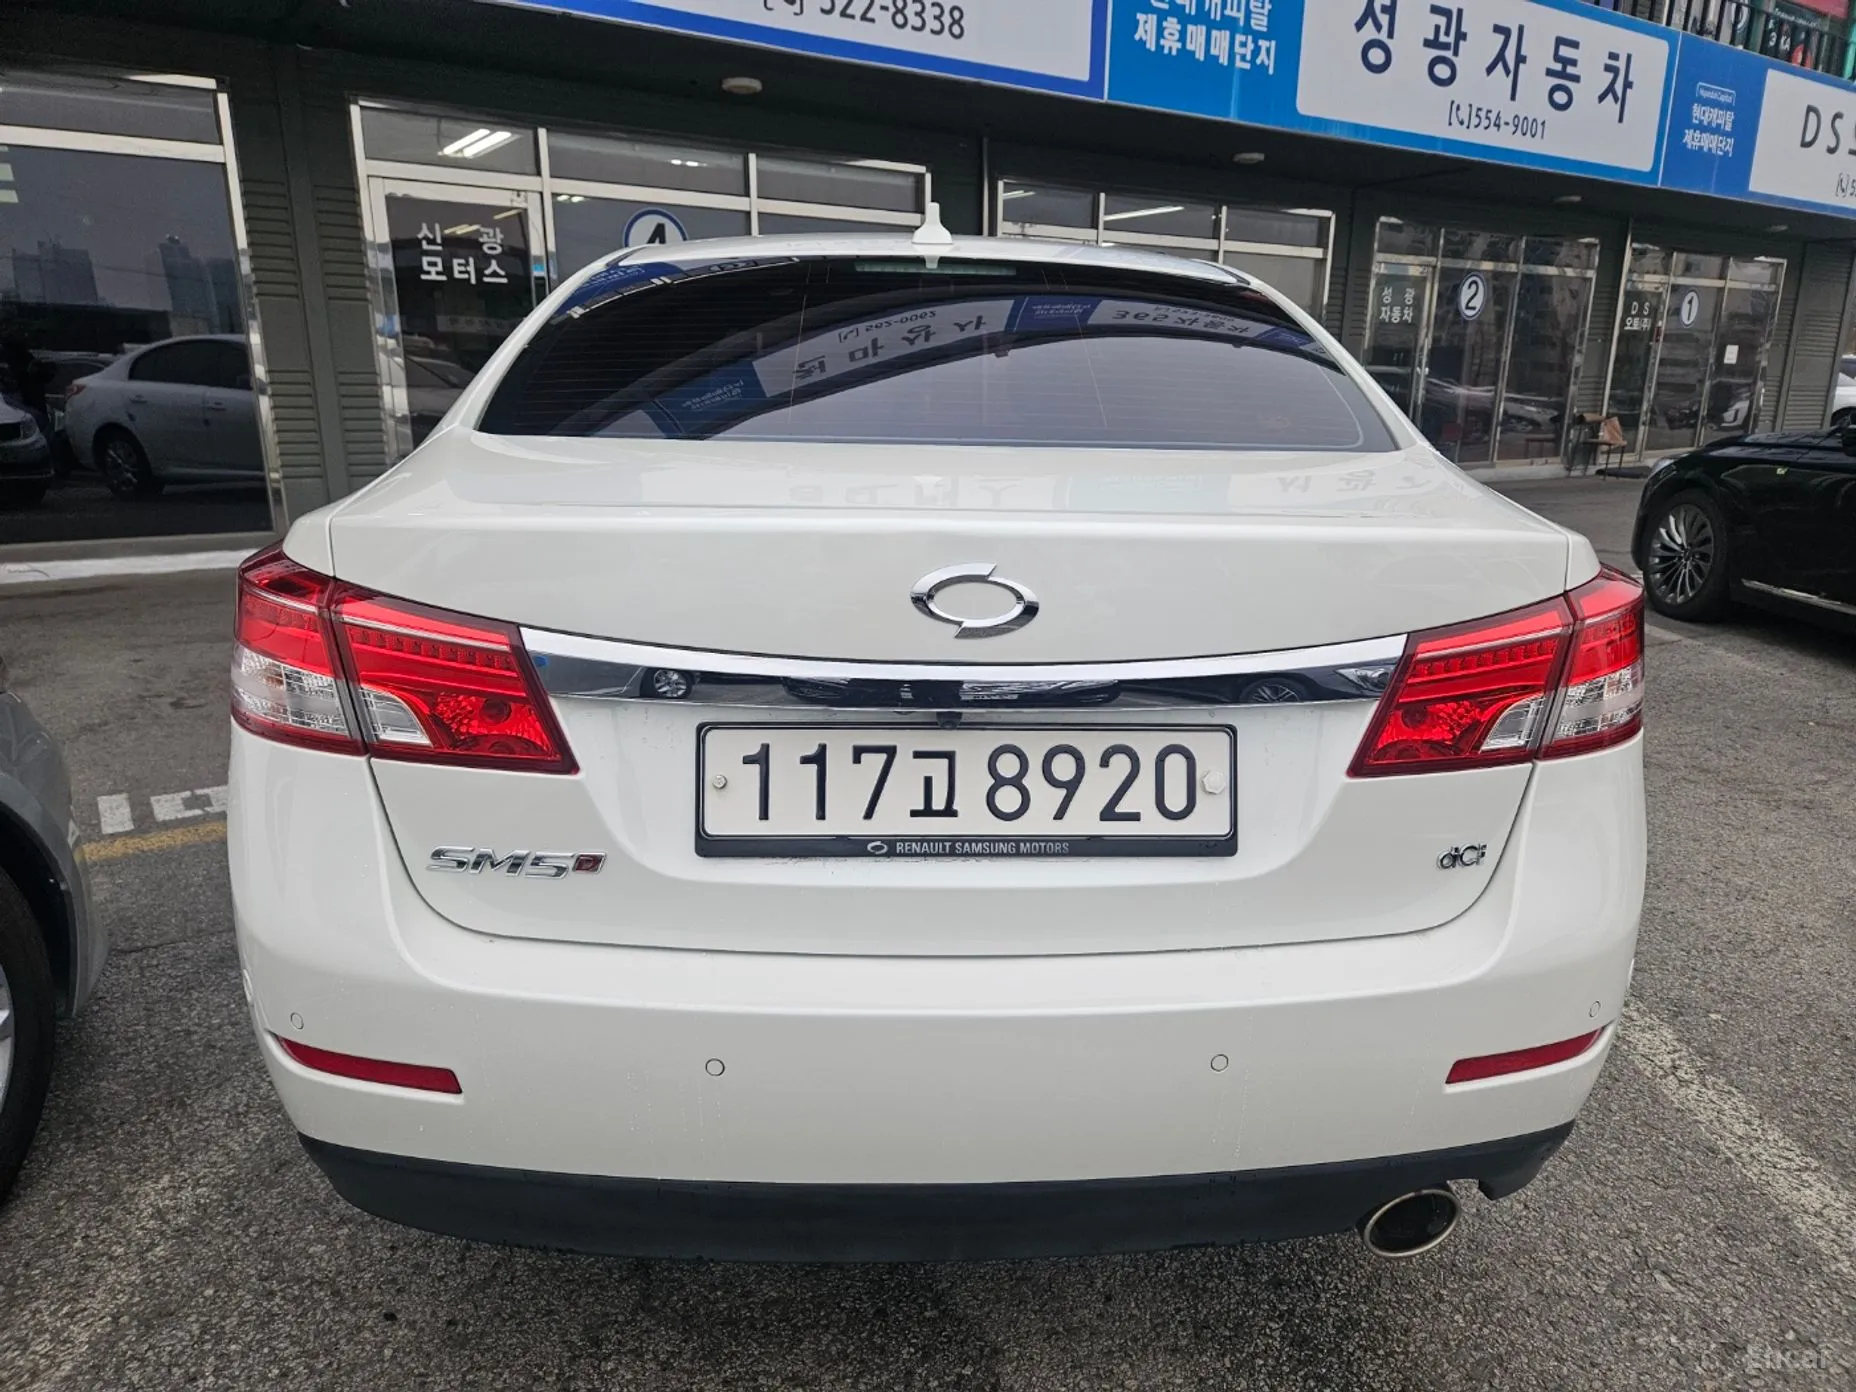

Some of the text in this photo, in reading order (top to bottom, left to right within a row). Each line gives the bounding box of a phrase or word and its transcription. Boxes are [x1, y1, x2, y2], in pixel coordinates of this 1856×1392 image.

[1134, 12, 1276, 75] 제휴매매단지
[420, 256, 508, 285] 모터스
[1464, 280, 1480, 311] 2
[1687, 295, 1695, 323] 1
[1379, 306, 1413, 324] 자동차
[742, 742, 1198, 822] 117고 8920
[896, 841, 1069, 854] RENAULT SAMSUNG MOTORS
[1437, 843, 1488, 870] dCi
